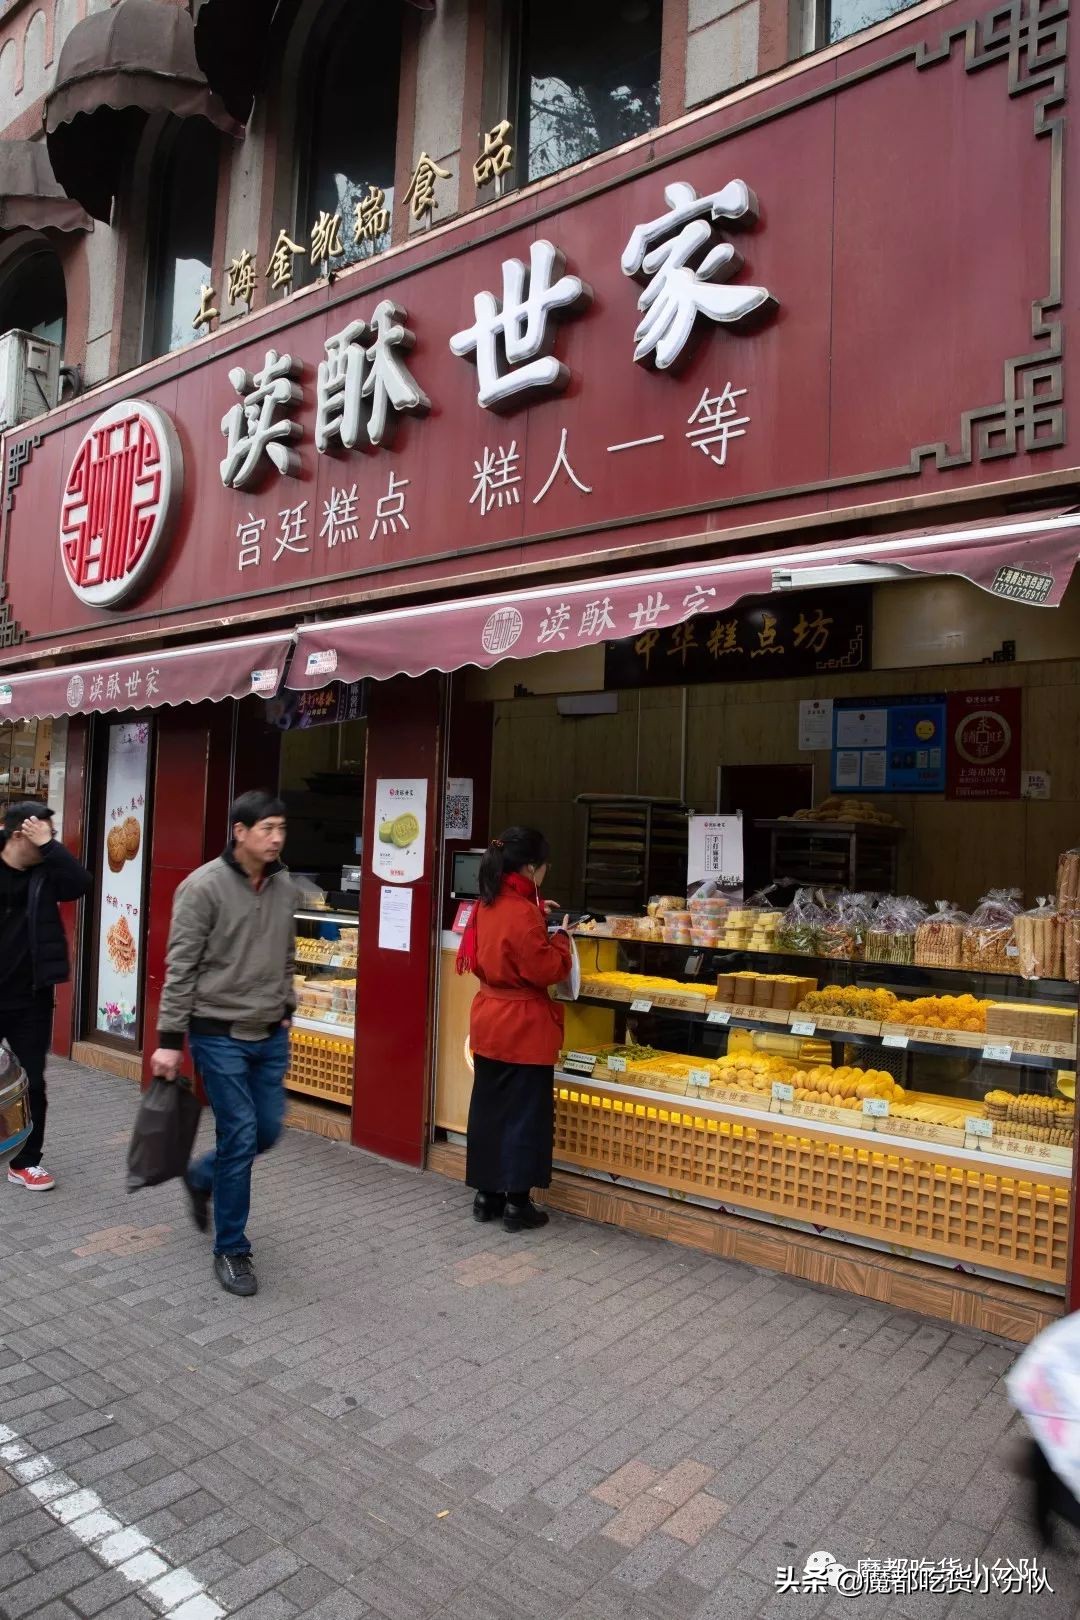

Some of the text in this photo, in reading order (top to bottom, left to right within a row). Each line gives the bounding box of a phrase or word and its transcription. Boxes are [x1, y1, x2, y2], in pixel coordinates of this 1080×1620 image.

[192, 119, 513, 330] 上海金凯瑞食品
[220, 178, 774, 488] 读酥世家
[236, 382, 751, 571] 宫廷糕点 糕人一等
[537, 585, 717, 643] 读酥世家
[635, 609, 834, 671] 中华糕点坊
[89, 667, 160, 702] 读酥世家
